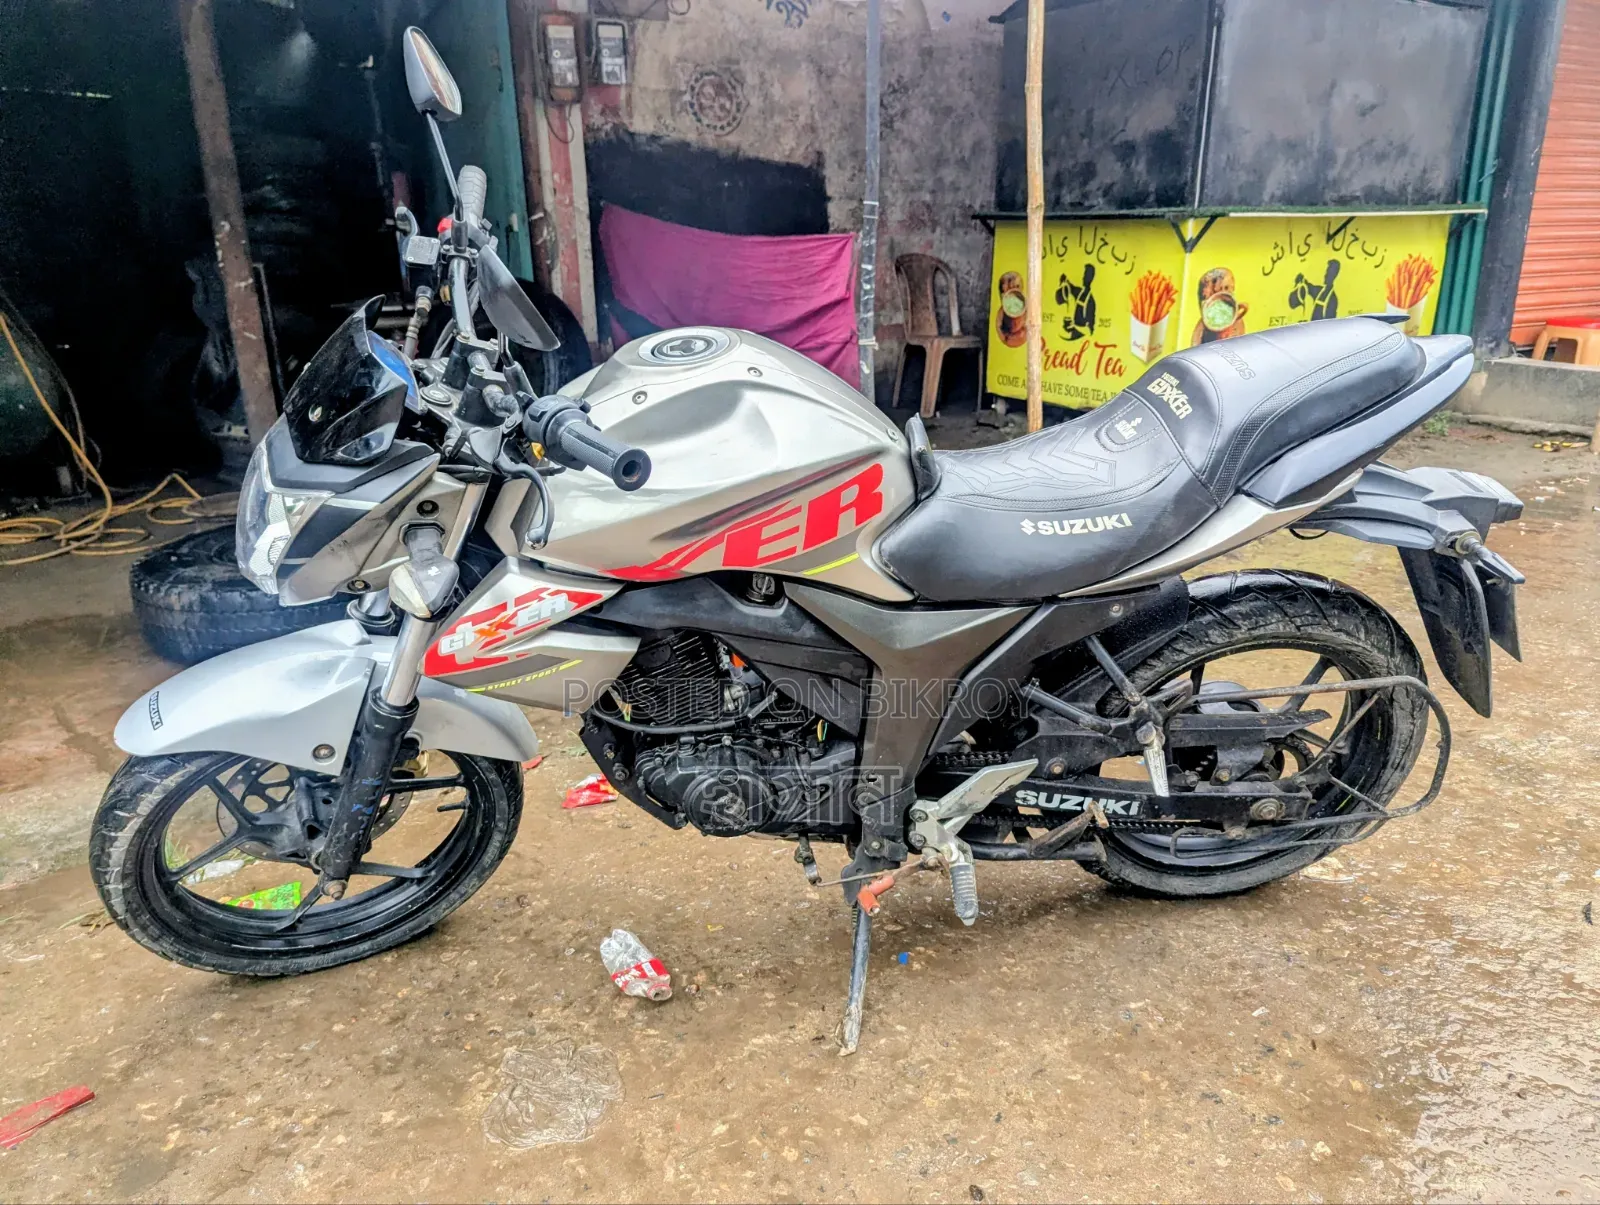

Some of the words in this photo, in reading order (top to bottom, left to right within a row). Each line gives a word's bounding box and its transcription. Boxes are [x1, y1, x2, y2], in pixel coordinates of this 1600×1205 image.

[1041, 336, 1090, 376] read
[1093, 341, 1127, 379] Tea
[996, 373, 1020, 389] COME
[1041, 380, 1064, 396] HAVE
[1063, 384, 1090, 400] SOME
[1091, 388, 1108, 403] TEA
[1037, 512, 1133, 537] SUZUKI
[525, 666, 558, 682] SPORT
